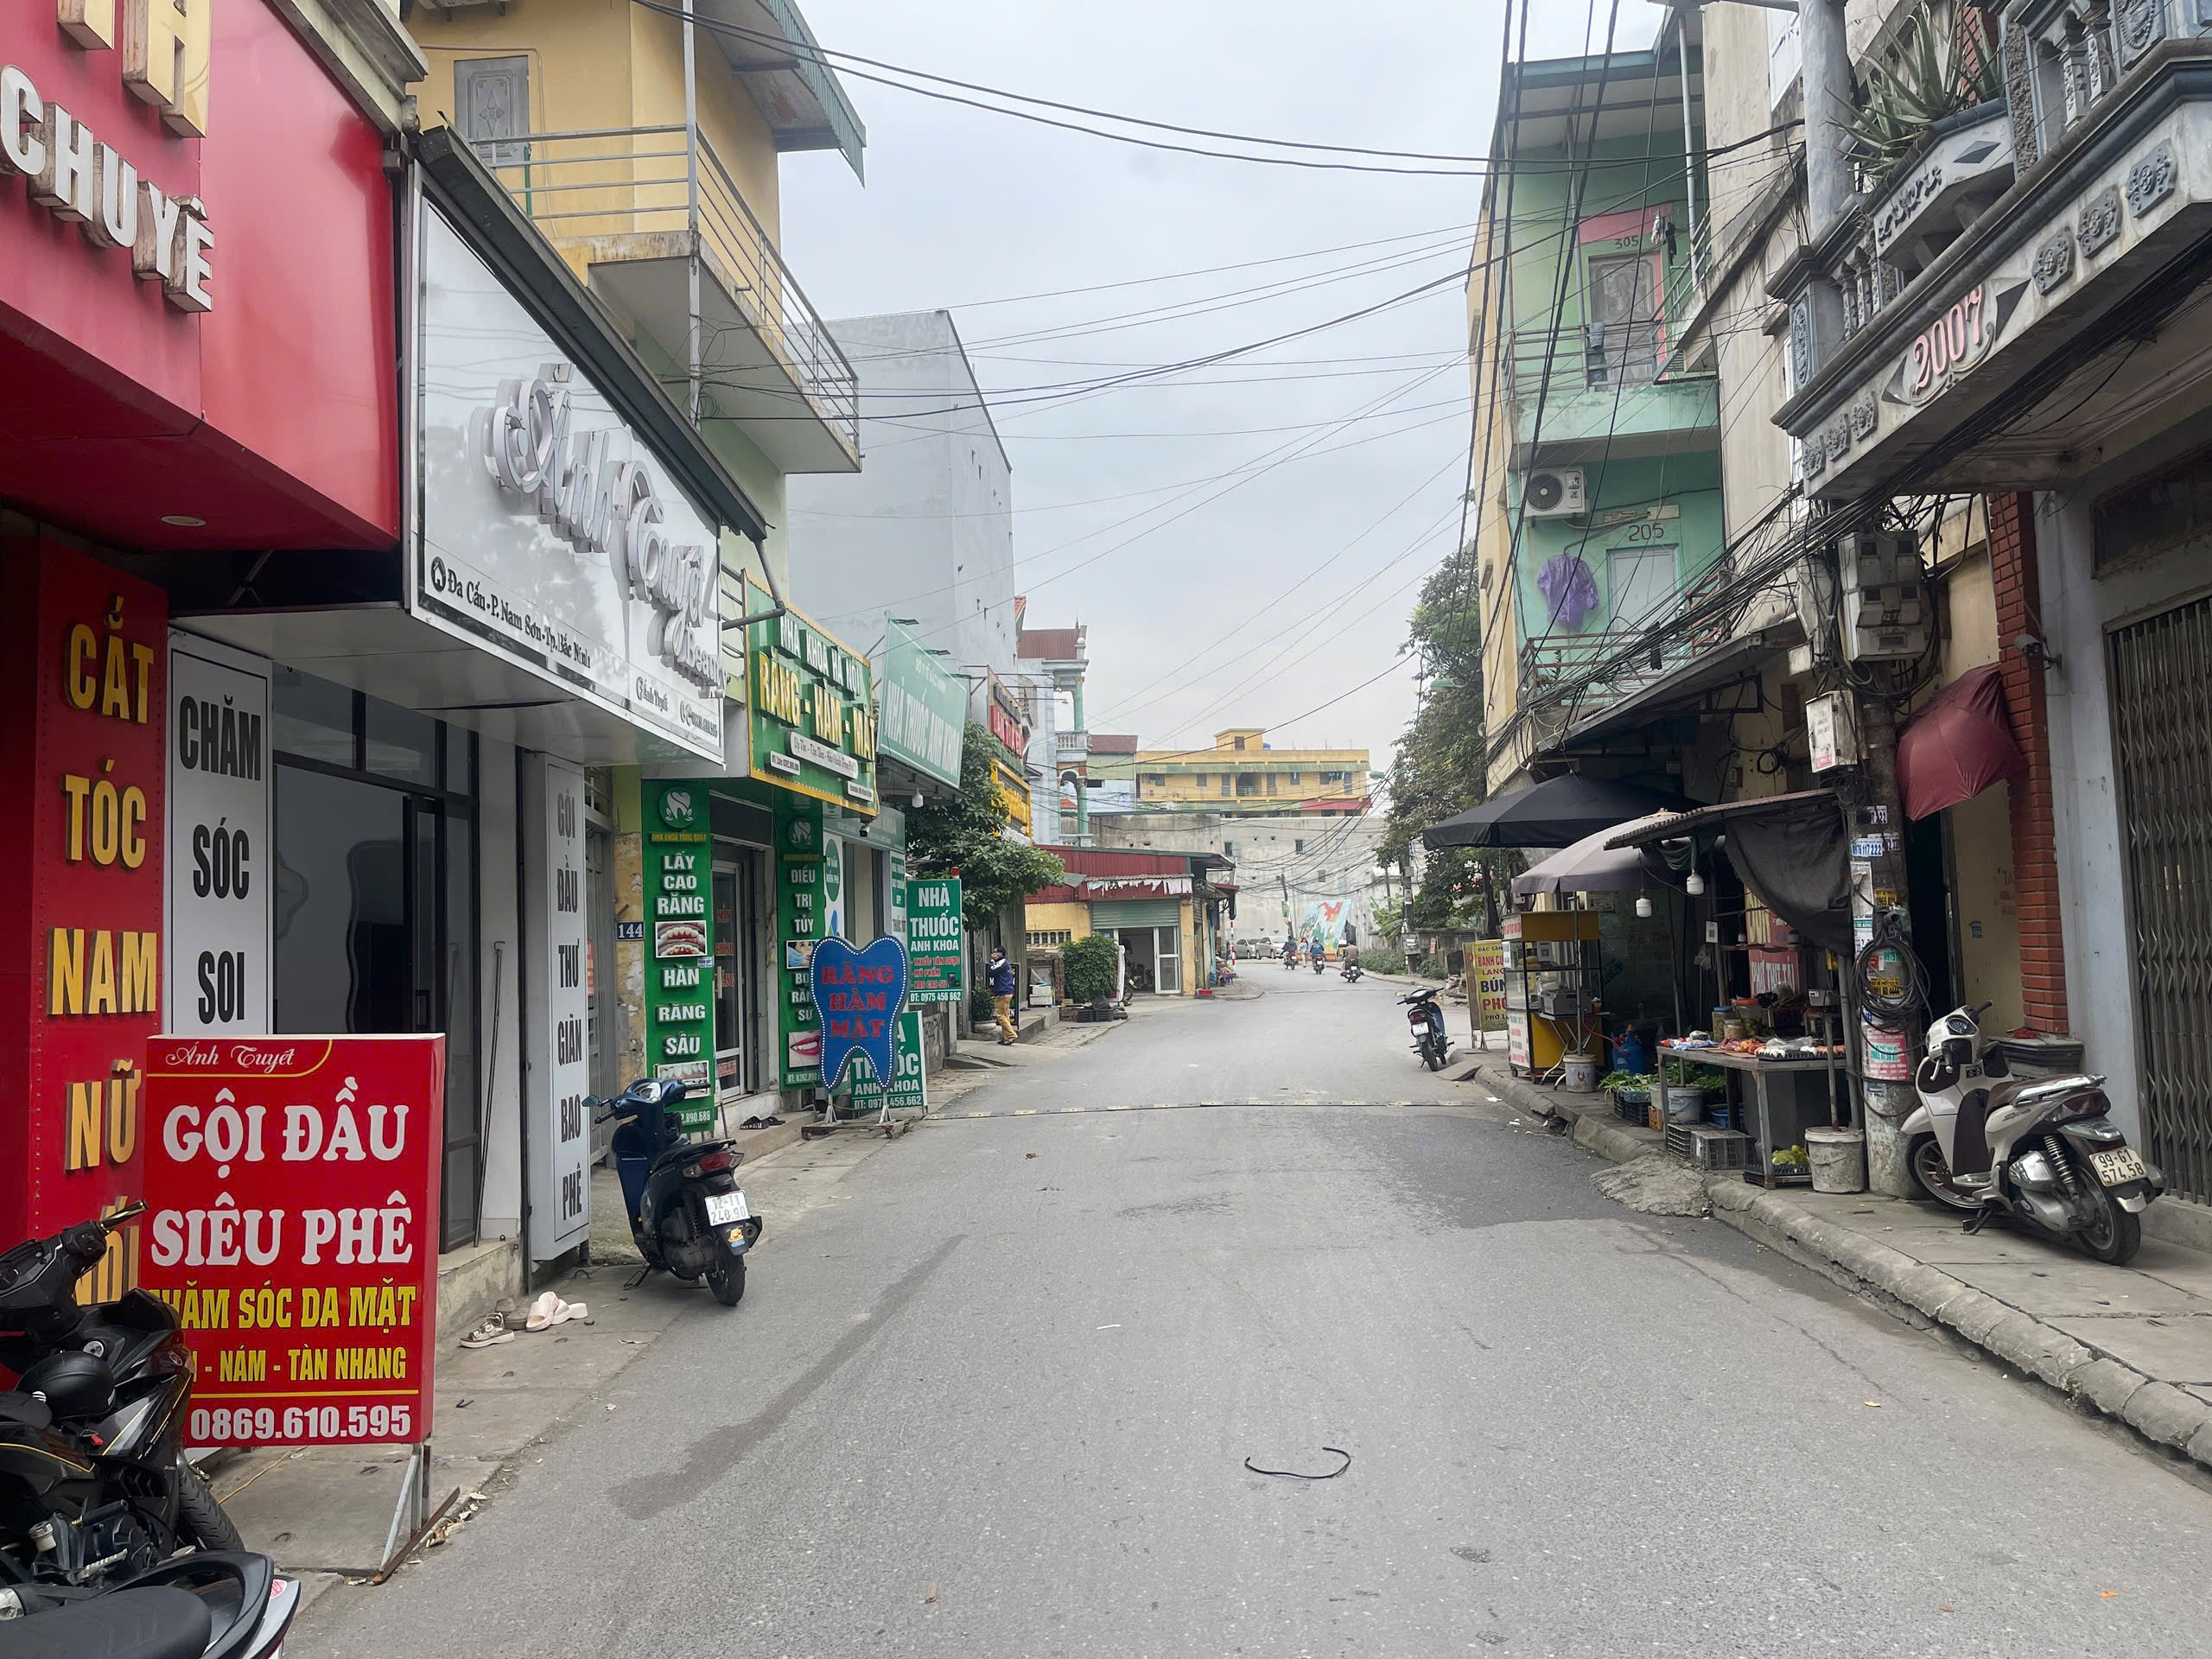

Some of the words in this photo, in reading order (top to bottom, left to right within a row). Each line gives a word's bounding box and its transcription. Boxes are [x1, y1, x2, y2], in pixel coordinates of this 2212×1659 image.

[1615, 235, 1638, 249] 305
[1914, 283, 1986, 396] 2007
[1629, 523, 1664, 542] 205
[501, 599, 522, 631] Nam
[574, 641, 591, 669] Ninh
[67, 595, 154, 724] CẮT
[806, 632, 830, 677] KHOA
[760, 645, 802, 726] RĂNG
[814, 677, 842, 747] HÀM
[885, 676, 904, 744] NHÀ
[179, 695, 261, 781] CHĂM
[62, 760, 146, 869] TÓC
[558, 787, 575, 847] GỘI
[193, 817, 250, 899] SÓC
[664, 851, 695, 870] LẤY
[556, 855, 578, 913] ĐẦU
[664, 875, 697, 889] CAO
[918, 883, 950, 907] NHÀ
[658, 893, 704, 914] RĂNG
[795, 893, 812, 911] TRỊ
[619, 924, 643, 938] 144
[794, 914, 814, 932] TỦY
[910, 910, 959, 938] THUỐC
[911, 940, 931, 951] ANH
[933, 939, 959, 950] KHOA
[48, 927, 157, 1016] NAM
[558, 938, 579, 988] THƯ
[822, 961, 894, 985] RĂNG
[198, 950, 245, 1025] SOI
[664, 967, 699, 988] HÀN
[795, 973, 809, 987] BỌ
[914, 980, 925, 989] BAO
[791, 988, 810, 1003] RĂ
[830, 988, 886, 1011] HÀM
[921, 993, 936, 1002] 0975
[938, 992, 949, 1001] 456
[950, 991, 961, 1001] 662
[658, 1003, 705, 1021] RĂNG
[830, 1015, 886, 1043] MẶT
[165, 1041, 219, 1065] Ánh
[231, 1045, 296, 1074] Tuyết
[666, 1033, 700, 1055] SÂU
[855, 1083, 880, 1096] ANH
[868, 1096, 922, 1109] 097.456.662
[66, 1059, 142, 1172] NỮ
[162, 1087, 267, 1179] GỘI
[281, 1076, 410, 1162] ĐẦU
[561, 1093, 582, 1143] BAO
[2099, 1149, 2133, 1167] 99-G1
[2101, 1162, 2145, 1183] 574.58
[563, 1162, 582, 1221] PHÊ
[151, 1191, 285, 1267] SIÊU
[302, 1190, 413, 1265] PHÊ
[149, 1280, 231, 1330] ĂM
[238, 1279, 292, 1330] SÓC
[301, 1287, 340, 1328] DA
[347, 1276, 416, 1334] MẶT
[219, 1344, 266, 1382] NÁM
[288, 1343, 328, 1381] TÀN
[335, 1346, 406, 1380] NHANG
[190, 1405, 410, 1440] 0869.610.595
